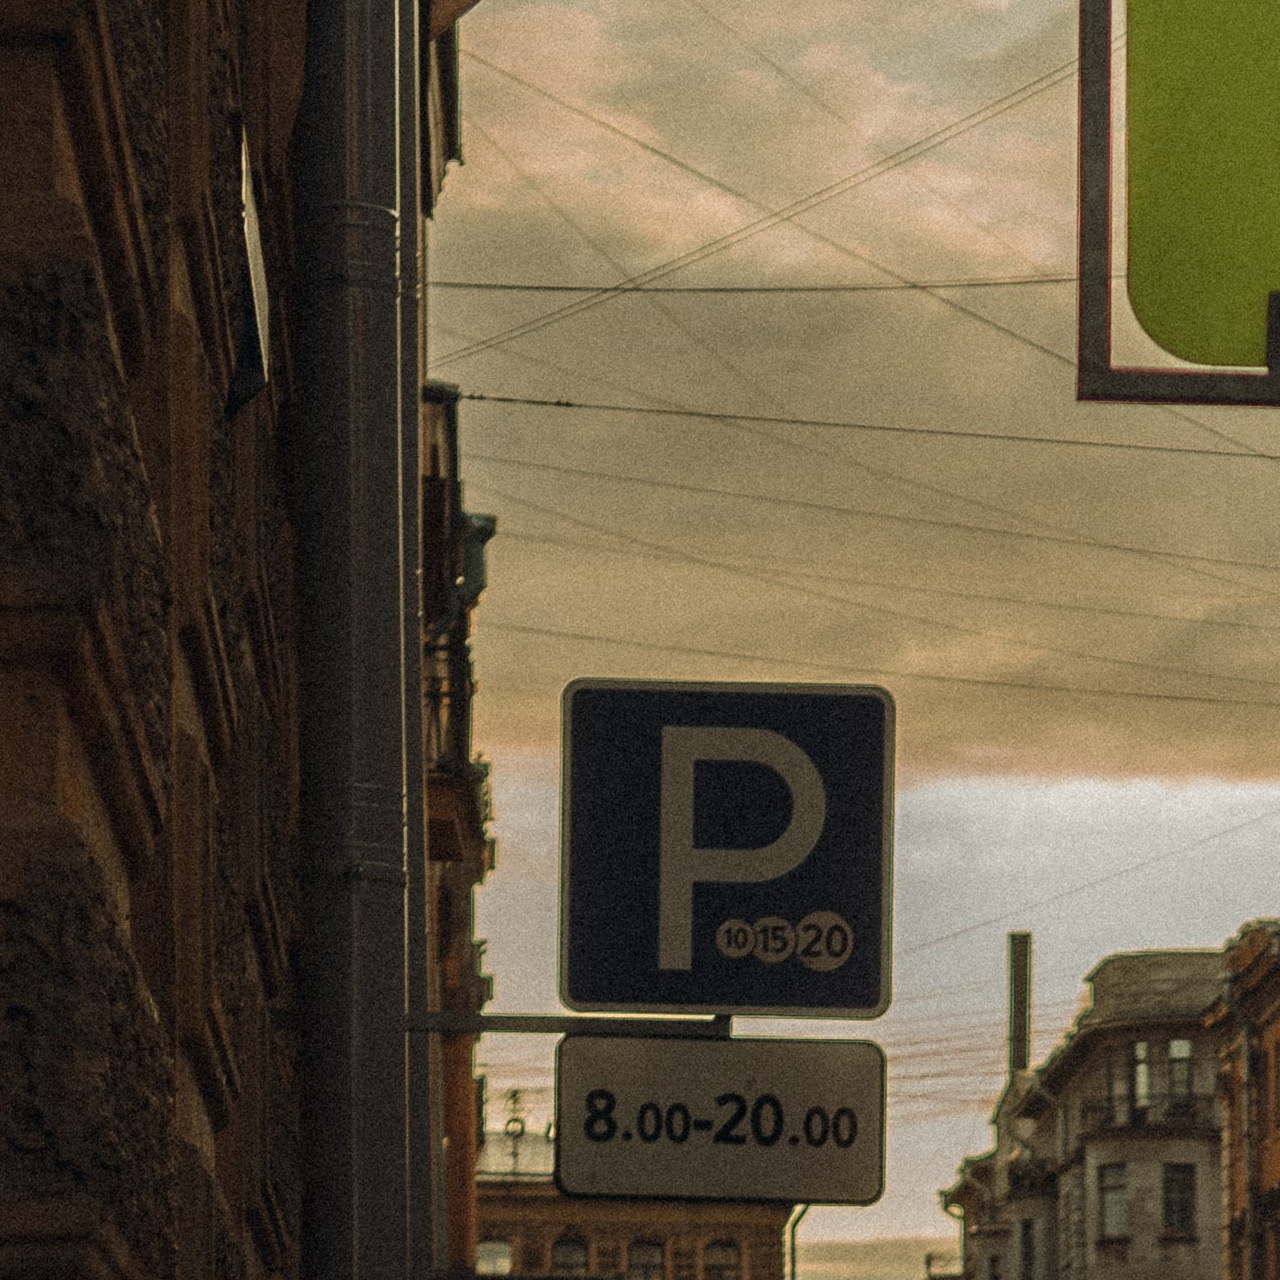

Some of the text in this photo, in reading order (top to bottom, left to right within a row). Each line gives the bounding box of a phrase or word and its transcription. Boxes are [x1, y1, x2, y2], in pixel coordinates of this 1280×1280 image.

[658, 725, 827, 971] P
[723, 923, 849, 959] 10 15 20
[584, 1088, 858, 1148] 8.00-20.00
